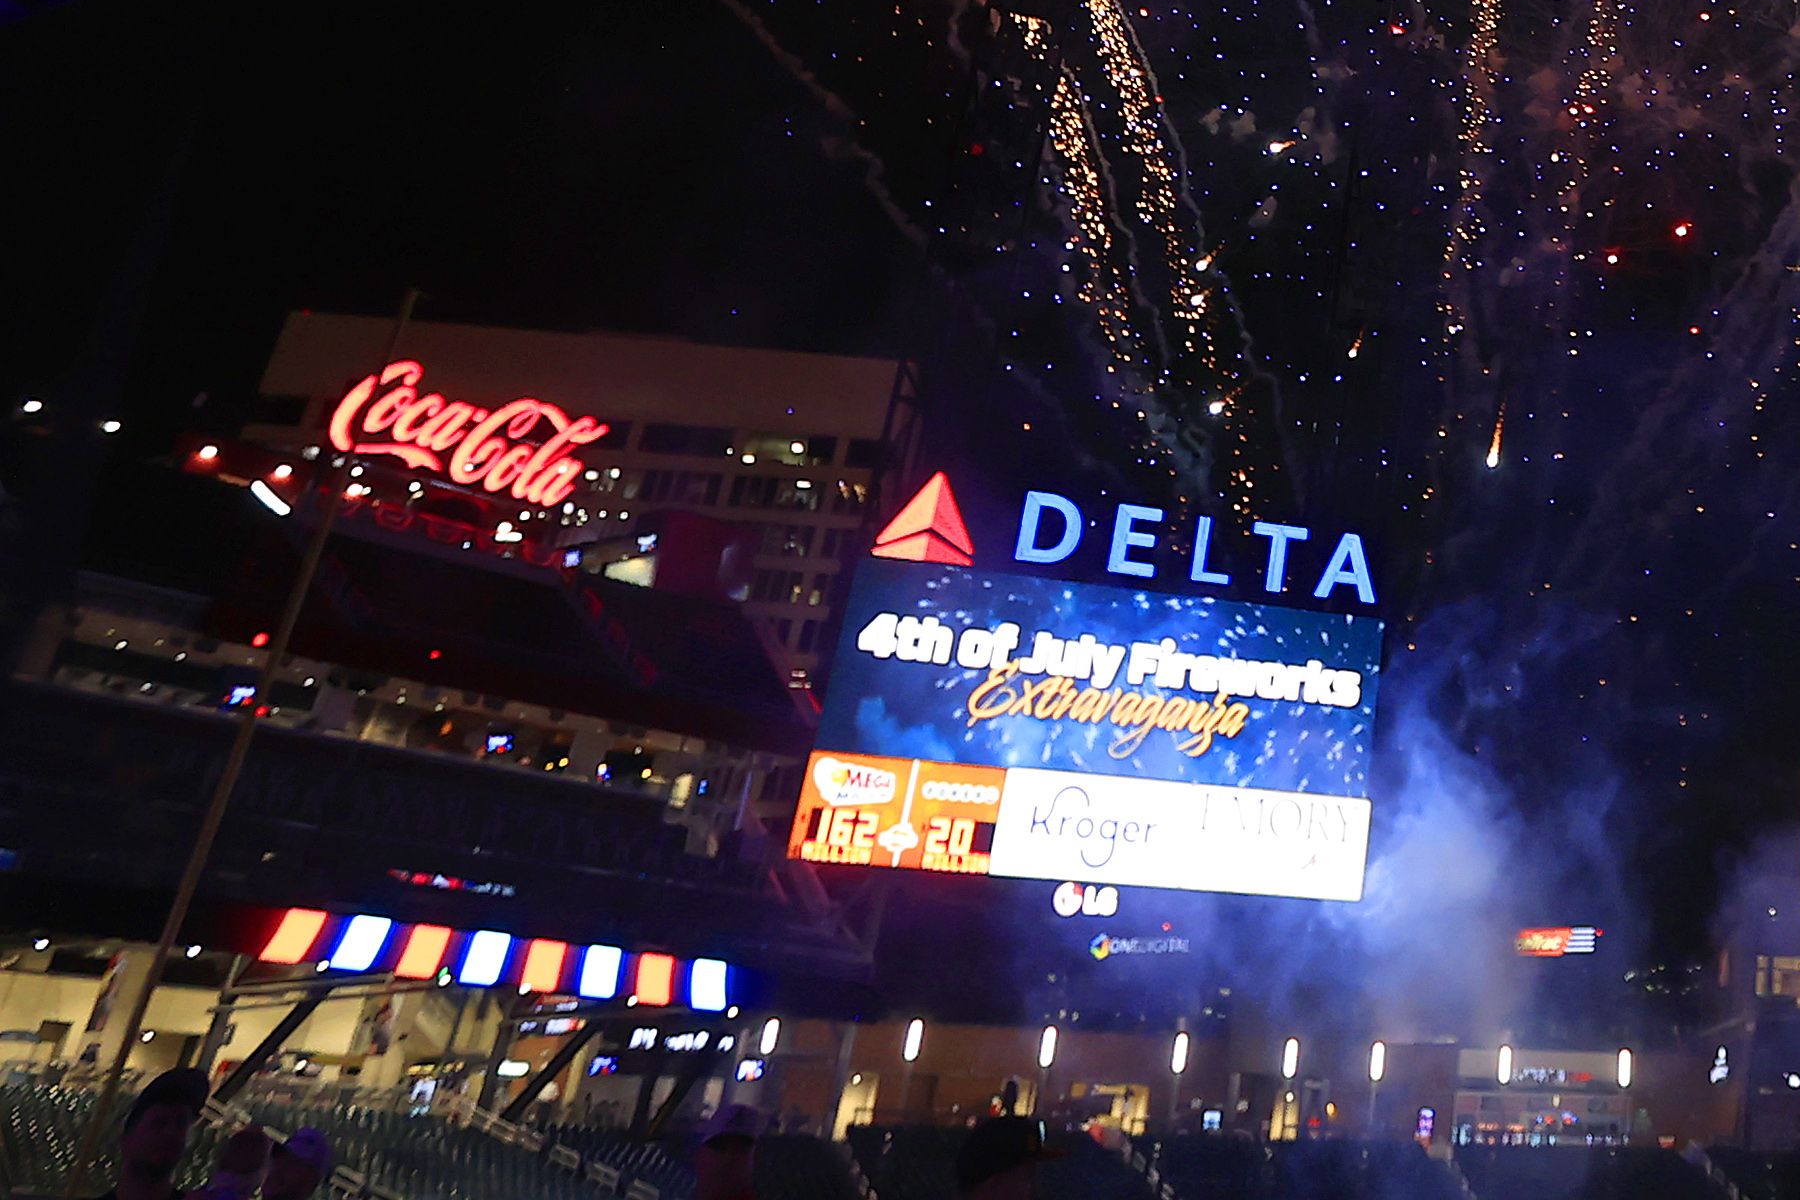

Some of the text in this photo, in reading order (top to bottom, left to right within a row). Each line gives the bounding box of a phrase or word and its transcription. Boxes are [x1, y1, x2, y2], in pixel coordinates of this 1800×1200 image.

[1014, 490, 1376, 604] DELTA
[857, 611, 1362, 708] 4th of July Fireworks
[966, 660, 1250, 759] Extravaganza
[816, 807, 880, 848] 162
[926, 816, 975, 856] 20
[1030, 786, 1157, 867] Kroger
[1082, 885, 1120, 916] LG
